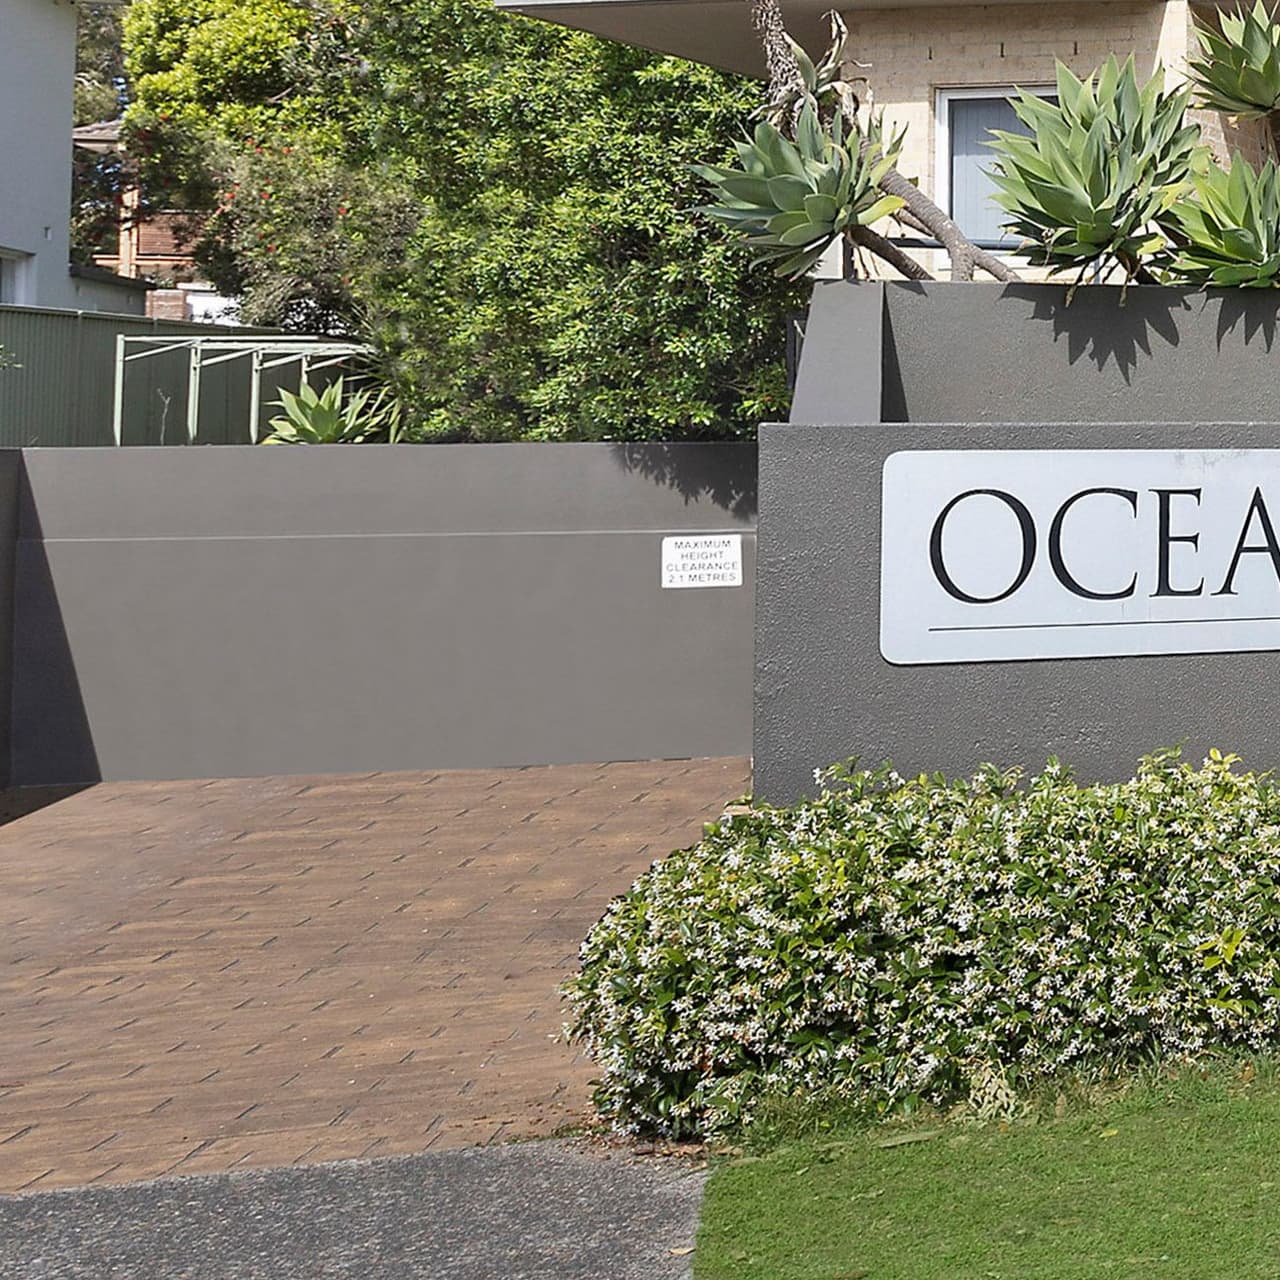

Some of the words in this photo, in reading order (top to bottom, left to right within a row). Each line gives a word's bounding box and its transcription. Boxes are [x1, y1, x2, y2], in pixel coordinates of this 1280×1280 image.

[674, 539, 731, 550] MAXIMUM
[680, 550, 724, 561] HEIGHT
[665, 561, 738, 573] CLEARANCE
[688, 572, 737, 583] METRES
